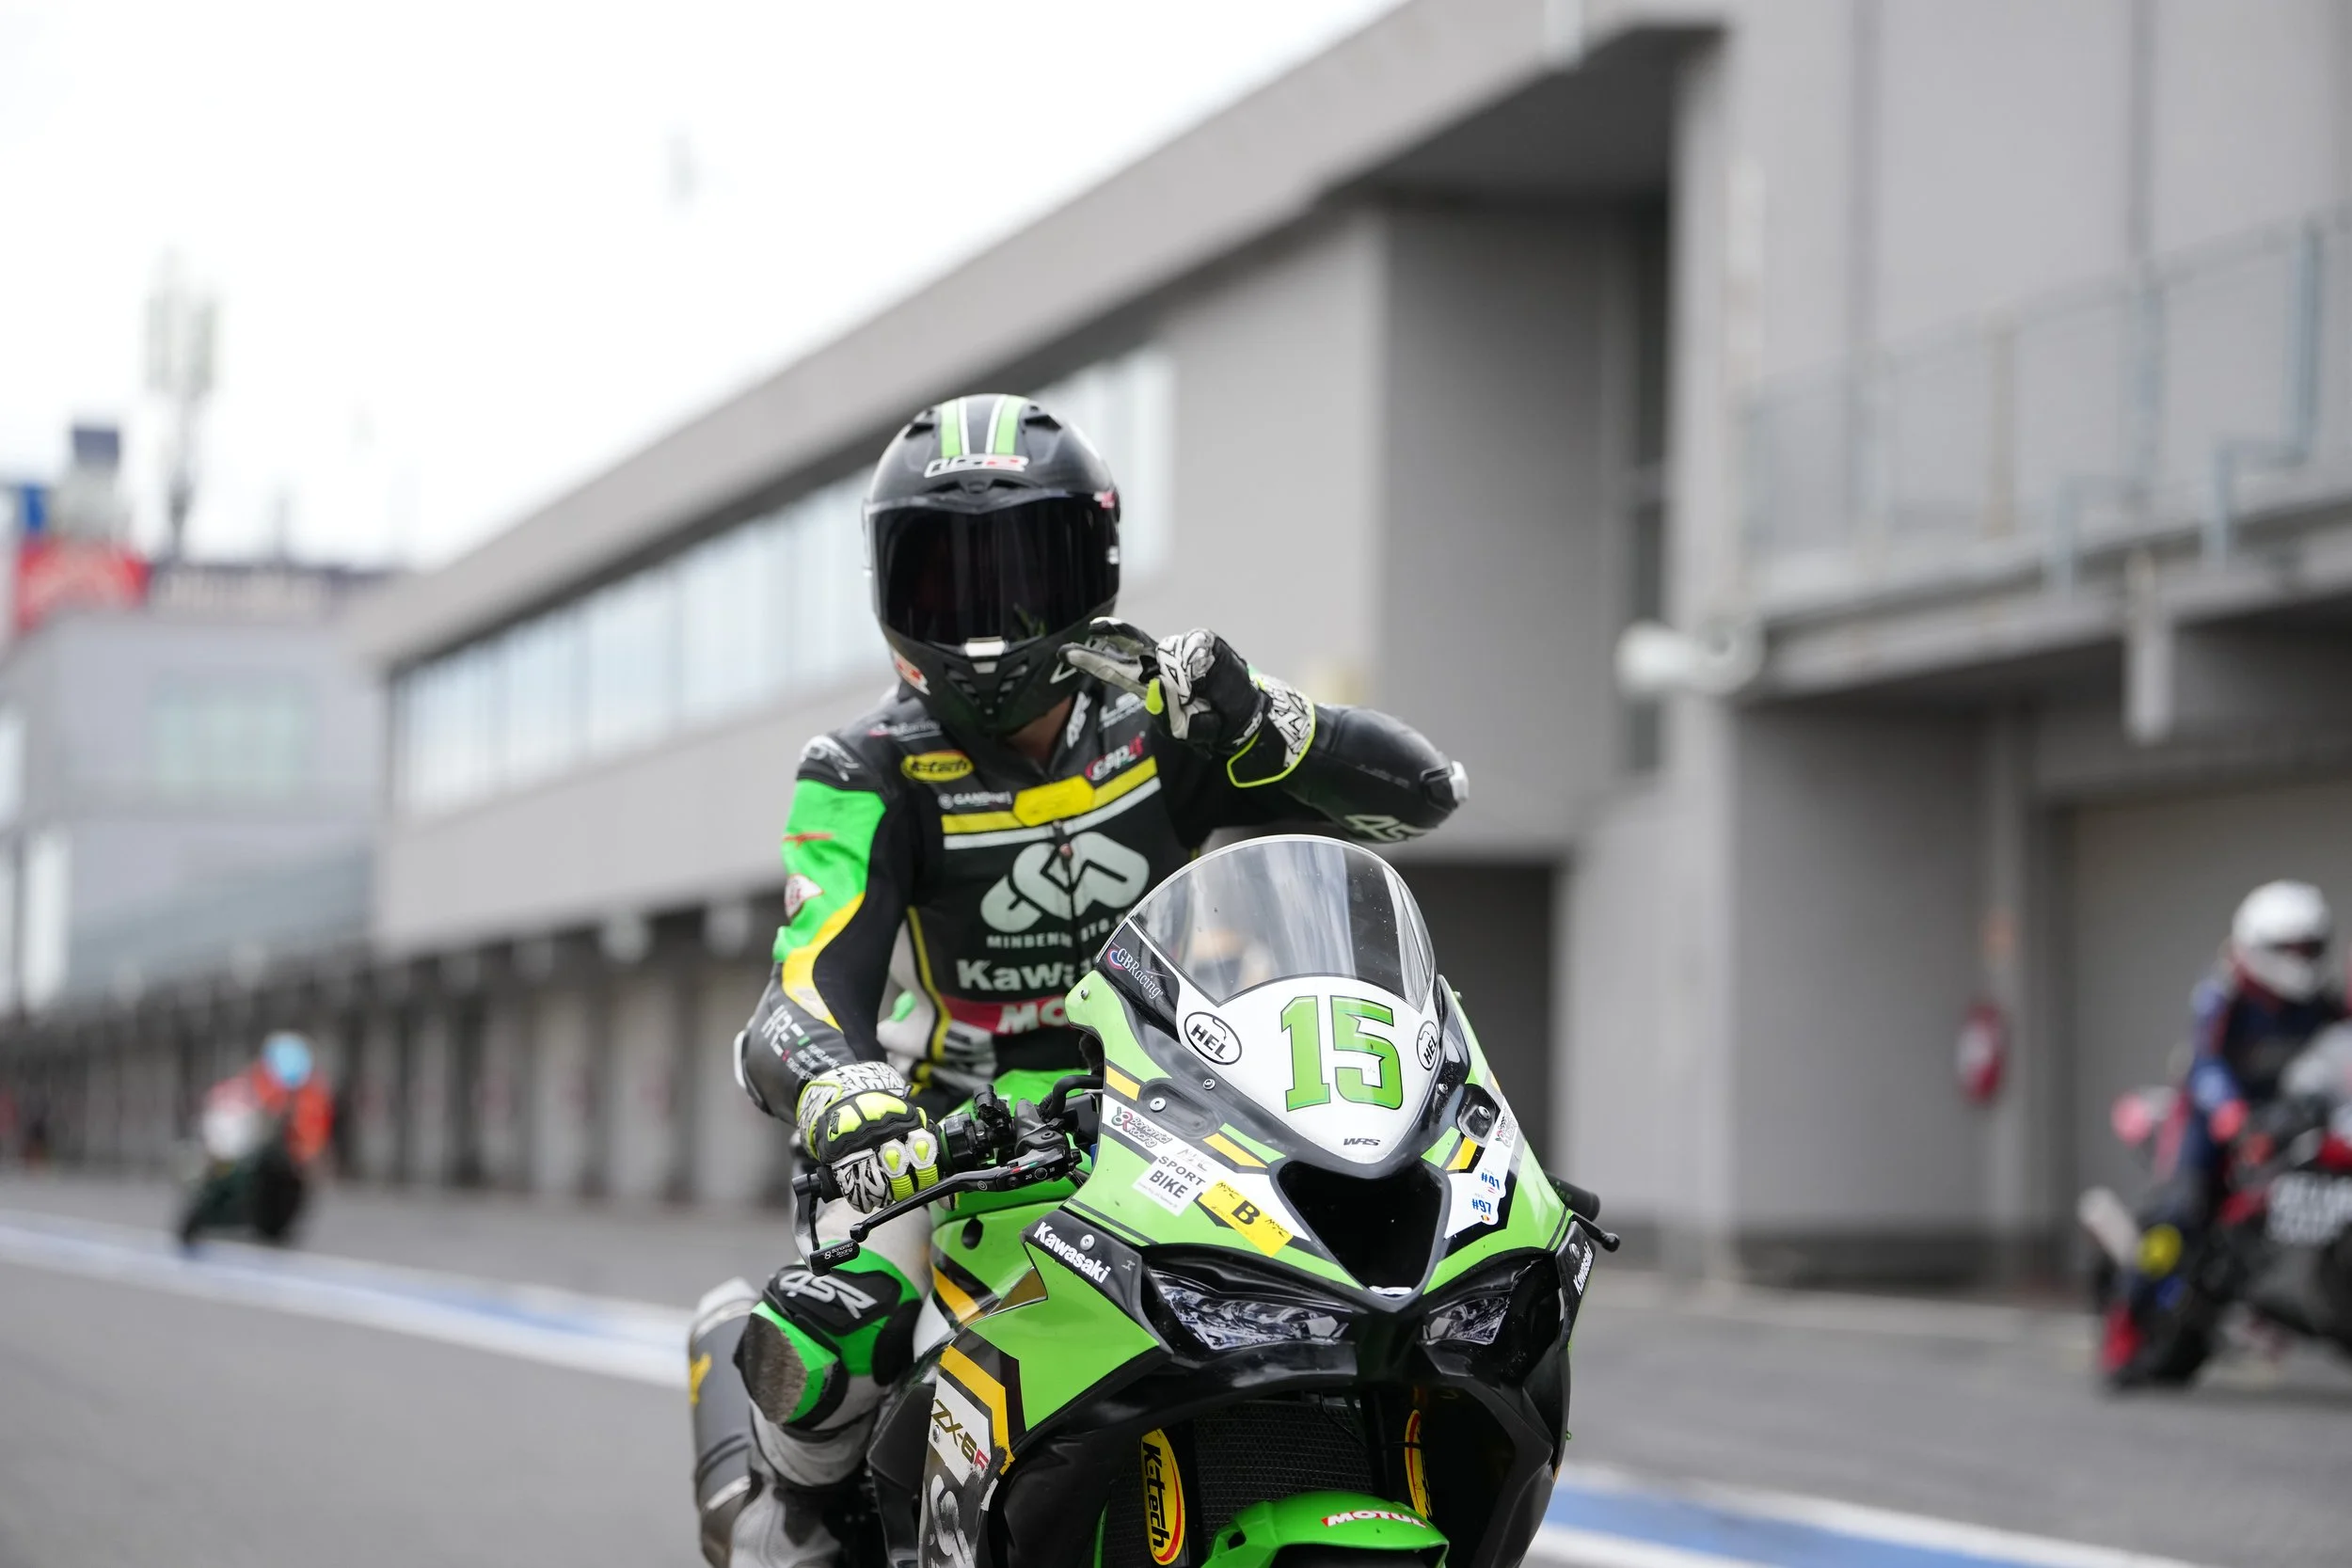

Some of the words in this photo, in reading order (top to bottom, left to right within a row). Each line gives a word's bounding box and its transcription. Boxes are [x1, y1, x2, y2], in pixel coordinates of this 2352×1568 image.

[1117, 948, 1162, 999] GBRacing
[1190, 1023, 1227, 1060] HEL
[1280, 994, 1404, 1113] 15
[1423, 1036, 1438, 1066] HEL
[1343, 1137, 1381, 1147] WRS
[1149, 1169, 1188, 1198] BIKE
[1158, 1155, 1206, 1186] SPORT
[1481, 1171, 1501, 1191] #41
[1232, 1199, 1261, 1226] B
[1471, 1197, 1492, 1215] #97
[1034, 1221, 1112, 1284] Kawasaki
[1573, 1241, 1594, 1296] Kawasaki
[1327, 1510, 1426, 1528] MOTUL
